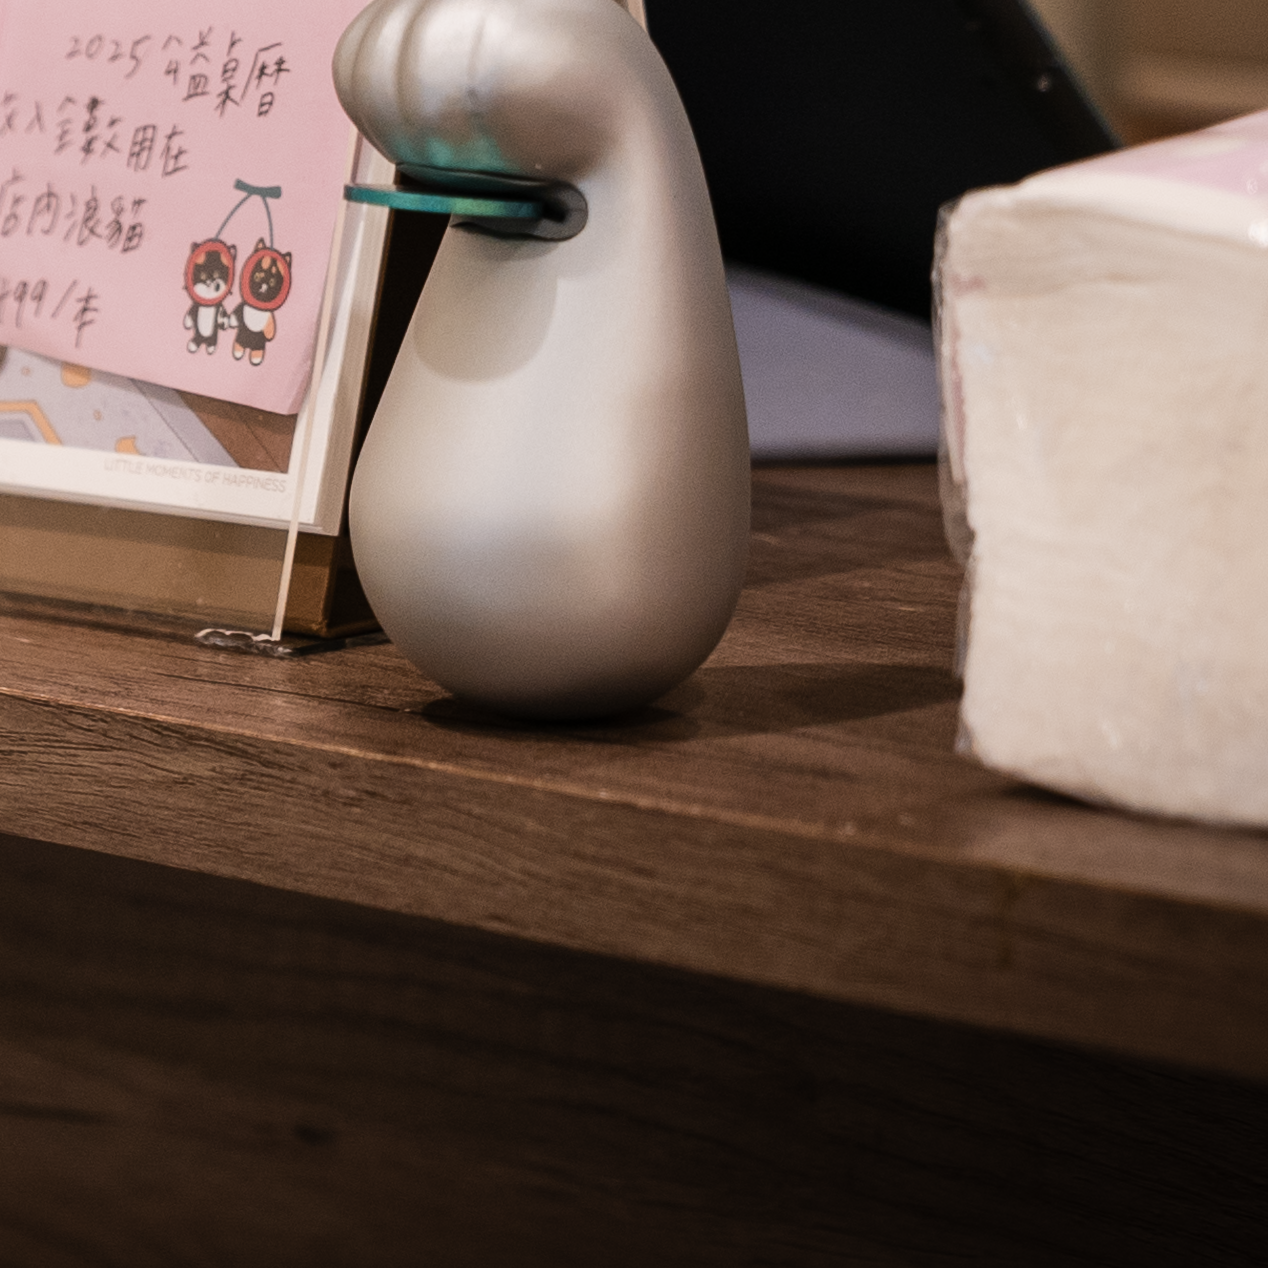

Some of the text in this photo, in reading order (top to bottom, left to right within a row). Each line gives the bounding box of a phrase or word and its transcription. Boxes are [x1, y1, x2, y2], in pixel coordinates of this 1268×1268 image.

[103, 458, 287, 493] LITTLE MOMENTS OF HAPPINESS
